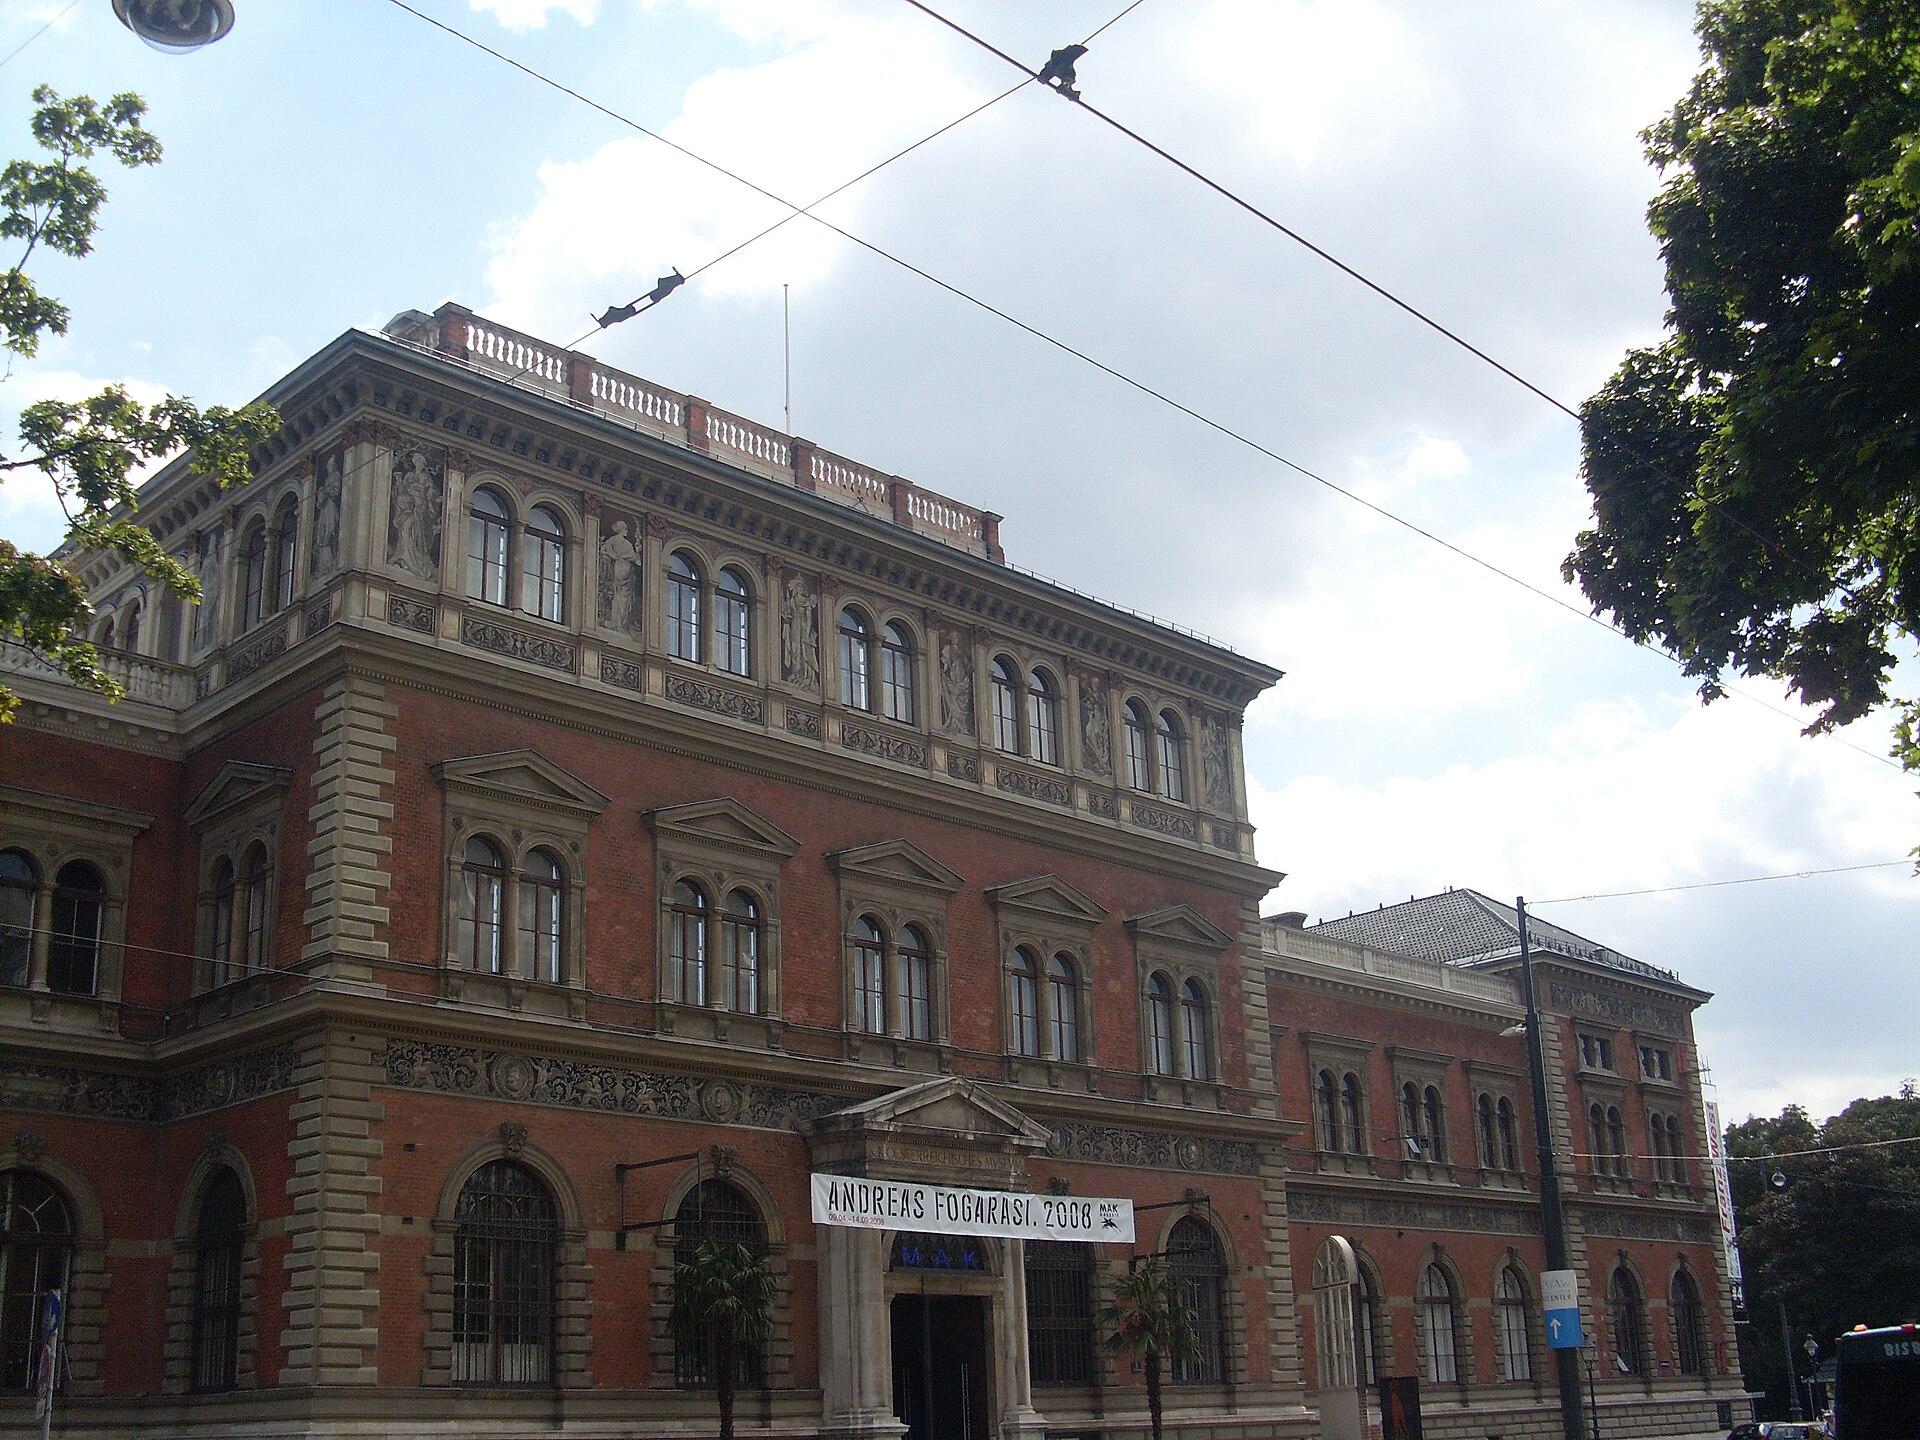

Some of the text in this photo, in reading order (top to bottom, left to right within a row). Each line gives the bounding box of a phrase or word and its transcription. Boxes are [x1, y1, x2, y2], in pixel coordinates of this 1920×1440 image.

[1706, 1102, 1720, 1159] West
[828, 1181, 1092, 1230] ANDREAS FOGARASI. 2008
[1099, 1203, 1118, 1213] MAK
[1716, 1164, 1730, 1234] Franz
